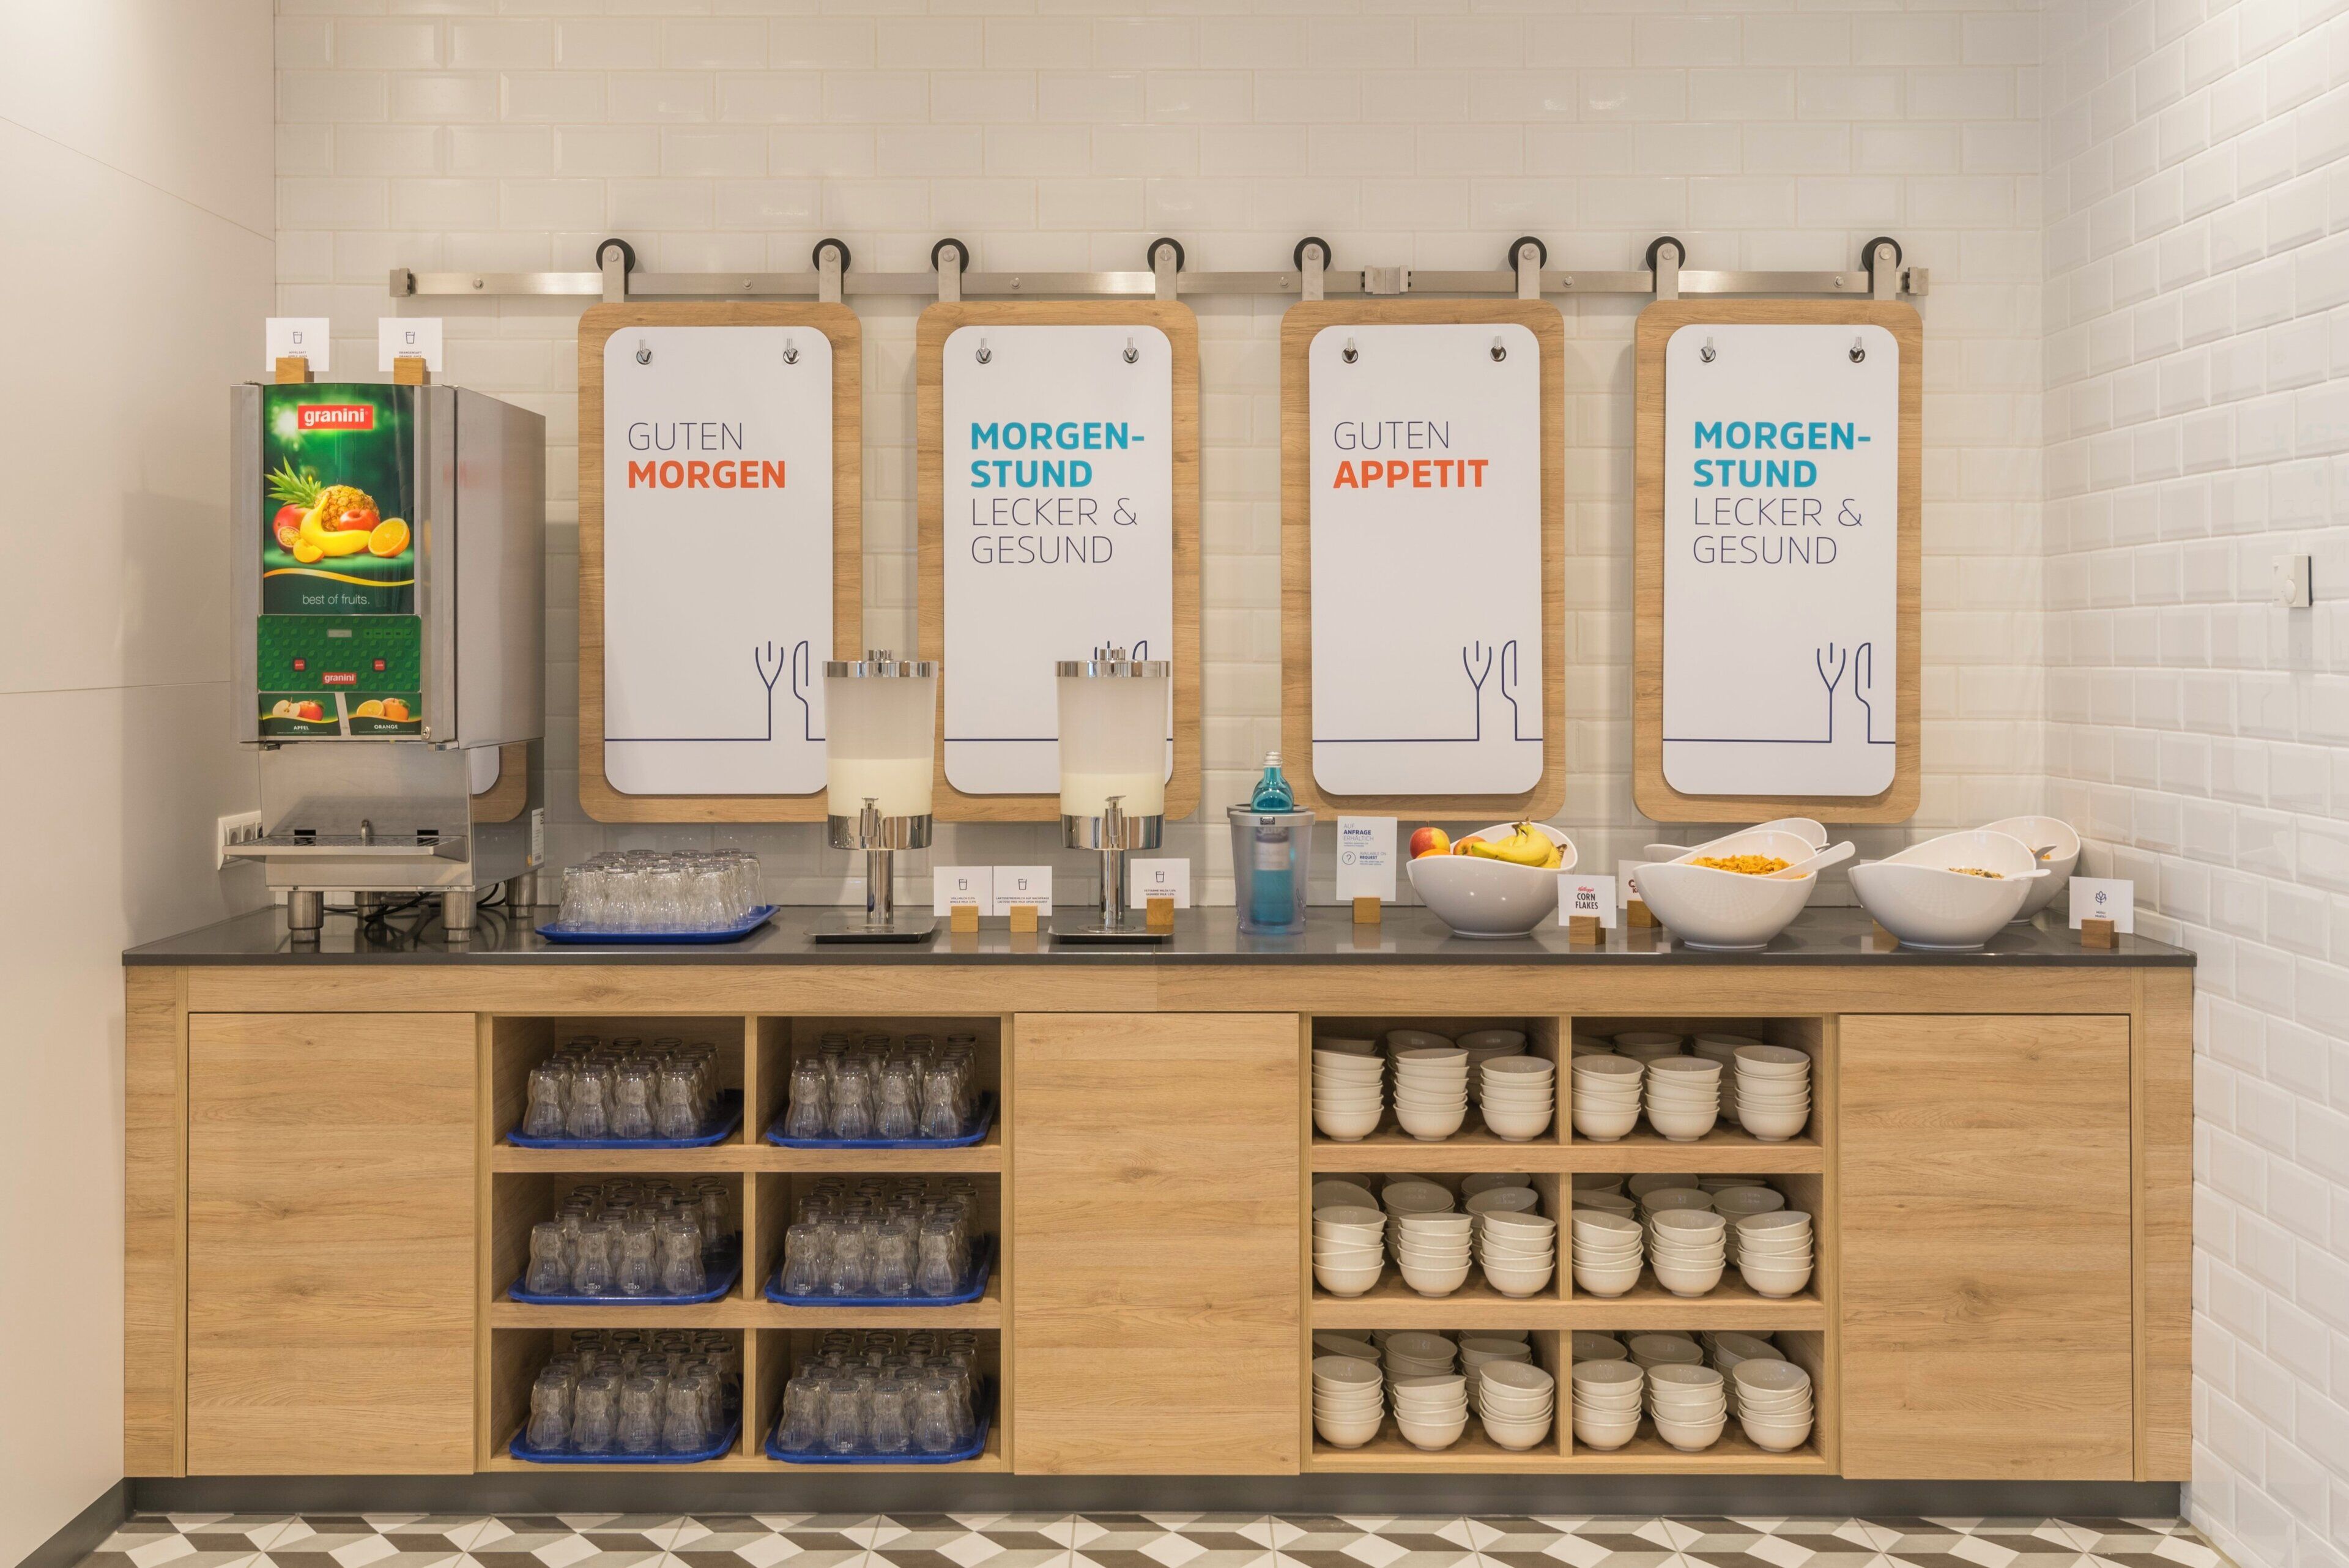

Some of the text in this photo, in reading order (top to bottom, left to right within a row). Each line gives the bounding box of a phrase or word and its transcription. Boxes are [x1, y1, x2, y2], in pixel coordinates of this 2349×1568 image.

[304, 408, 365, 426] granini
[628, 422, 742, 450] GUTEN
[971, 422, 1145, 450] MORGEN-
[1334, 421, 1449, 450] GUTEN
[1694, 421, 1871, 450] MORGEN-
[628, 460, 785, 489] MORGEN
[971, 460, 1093, 488] STUND
[1333, 459, 1489, 488] APPETIT
[1693, 459, 1817, 488] STUND
[973, 497, 1137, 526] LECKER &
[1695, 497, 1862, 526] LECKER &
[971, 535, 1113, 563] GESUND
[1693, 535, 1837, 564] GESUND
[302, 593, 370, 604] best of fruits.
[324, 674, 354, 683] granini
[1575, 901, 1598, 910] FLAKES
[1576, 893, 1595, 901] CORN
